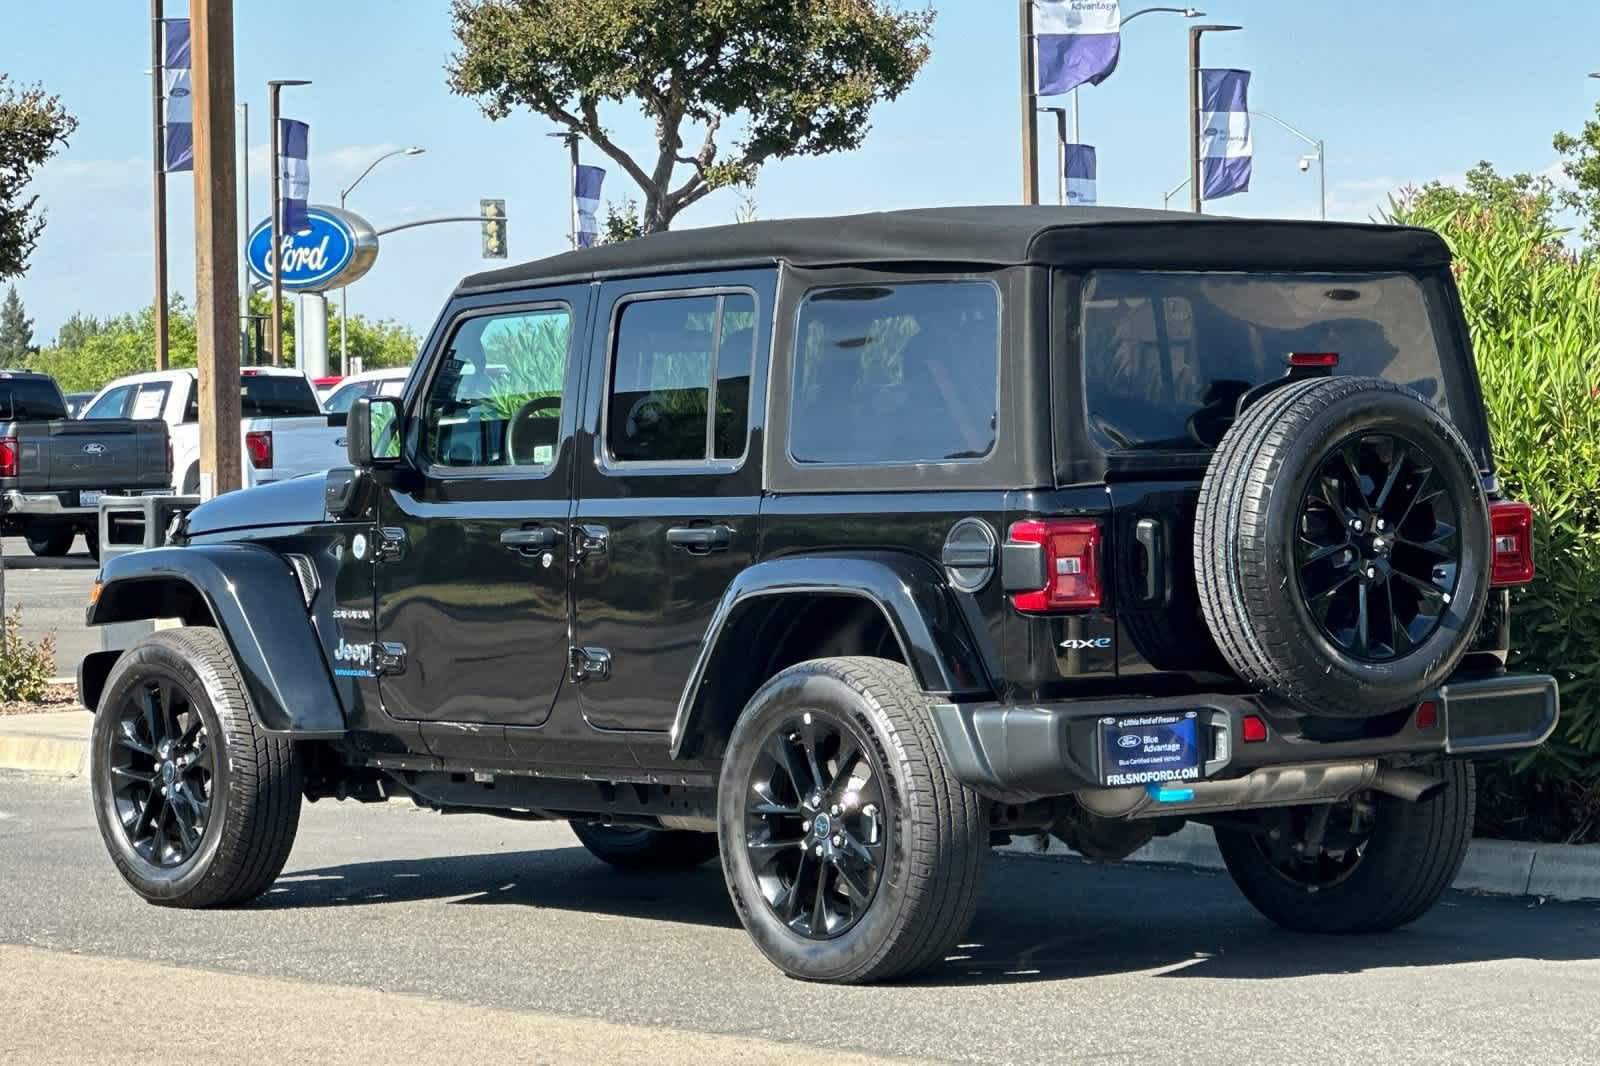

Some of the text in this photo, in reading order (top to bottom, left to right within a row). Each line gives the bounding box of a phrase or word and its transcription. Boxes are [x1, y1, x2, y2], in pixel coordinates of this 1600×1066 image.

[334, 638, 369, 666] Jeep
[1143, 736, 1159, 744] Blue
[1143, 744, 1181, 753] Advantage
